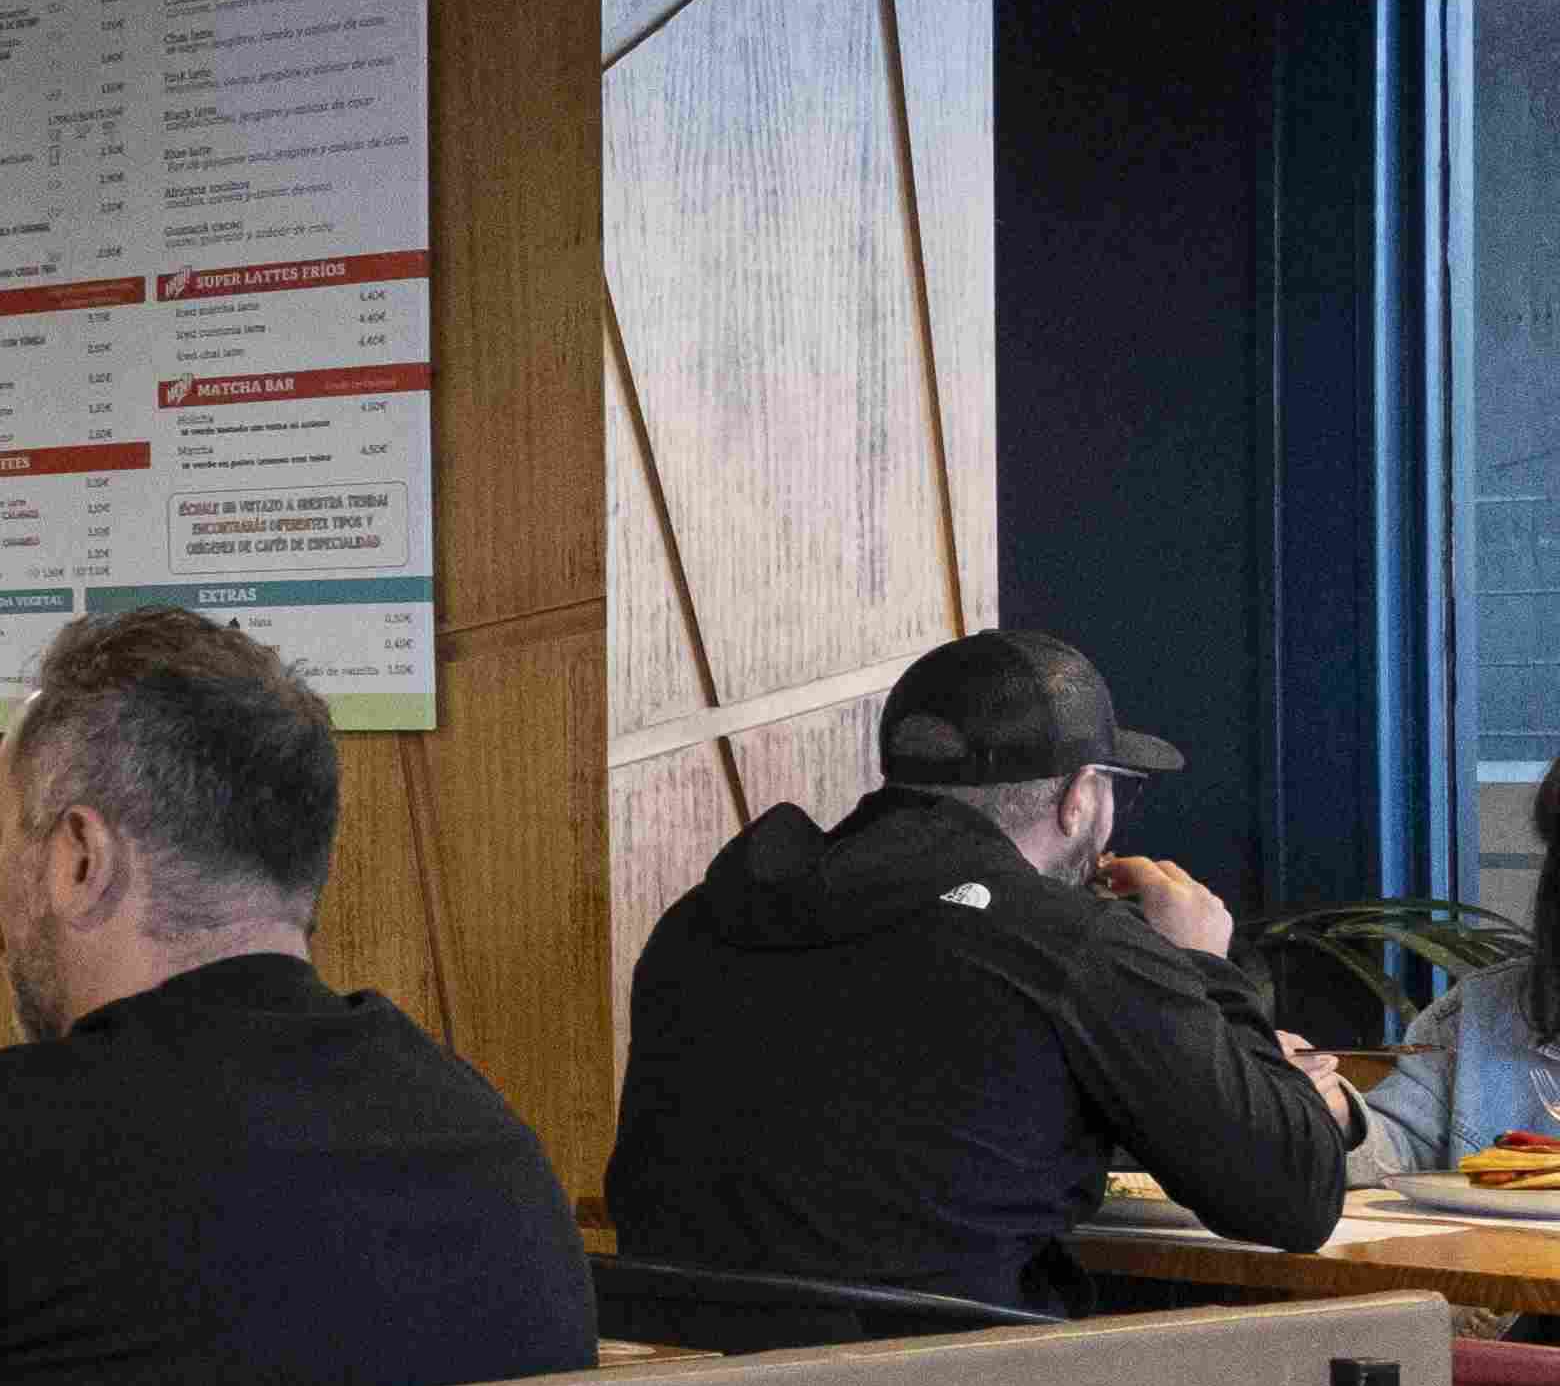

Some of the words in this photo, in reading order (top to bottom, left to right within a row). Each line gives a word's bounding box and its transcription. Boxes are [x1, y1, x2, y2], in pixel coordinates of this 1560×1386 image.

[196, 272, 240, 289] SUPER
[244, 268, 297, 284] LATTES
[196, 380, 261, 397] MATCHA
[265, 377, 295, 392] BAR
[199, 588, 257, 603] EXTRAS
